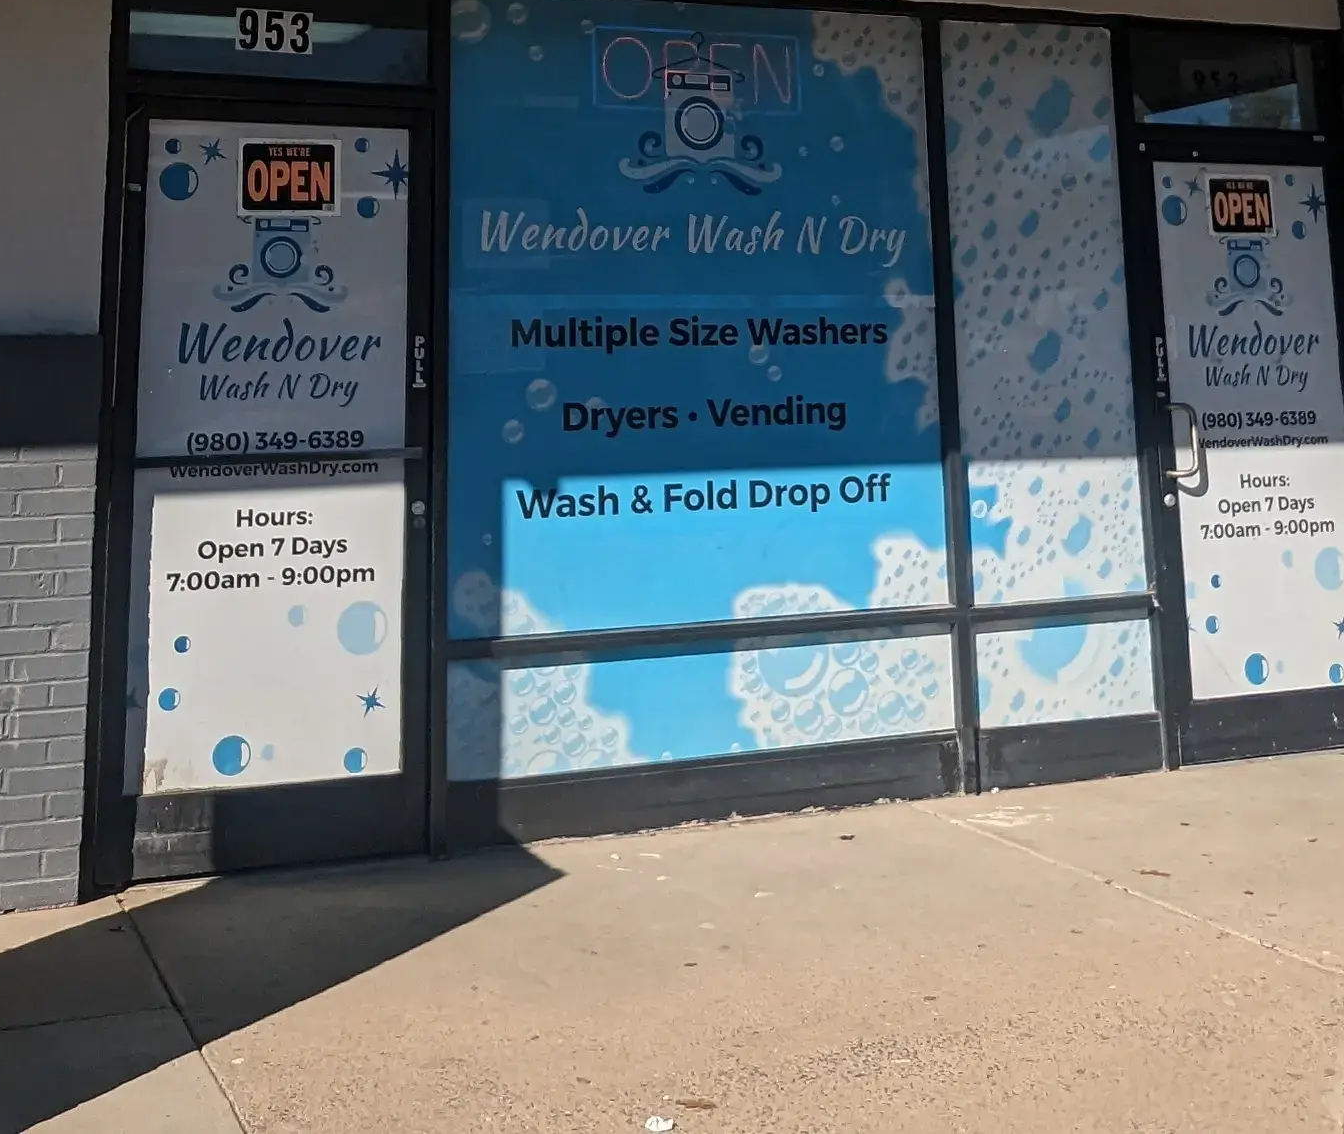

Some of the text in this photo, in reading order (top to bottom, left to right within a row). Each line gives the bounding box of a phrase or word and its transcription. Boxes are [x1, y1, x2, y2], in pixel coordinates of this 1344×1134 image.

[238, 9, 312, 54] 953
[601, 35, 794, 106] OPEN
[267, 146, 284, 158] YES
[247, 159, 332, 202] OPEN
[1213, 191, 1271, 227] OPEN
[478, 207, 907, 268] Wendover Wash N Dry
[177, 317, 382, 365] Wendover
[511, 316, 888, 353] Multiple Size Washers
[1187, 320, 1320, 358] Wendover
[413, 335, 427, 384] PULL
[198, 371, 359, 408] Wash N Dry
[1205, 363, 1309, 393] Wash N Dry
[562, 401, 679, 437] Dryers
[707, 396, 847, 431] Vending
[1201, 410, 1317, 430] (980) 349-6389
[186, 429, 365, 454] (980) 349-6389
[170, 461, 379, 478] WendoverWashDry.com
[1239, 472, 1290, 489] Hours:
[517, 473, 892, 519] Wash & Fold Drop Off
[1218, 496, 1316, 518] Open 7 Days
[236, 508, 314, 529] Hours:
[1200, 523, 1262, 540] 7:00am
[1274, 518, 1335, 539] 9:00pm
[197, 535, 349, 563] Open 7 Days
[166, 571, 260, 593] 7:00am
[281, 565, 376, 587] 9:00pm
